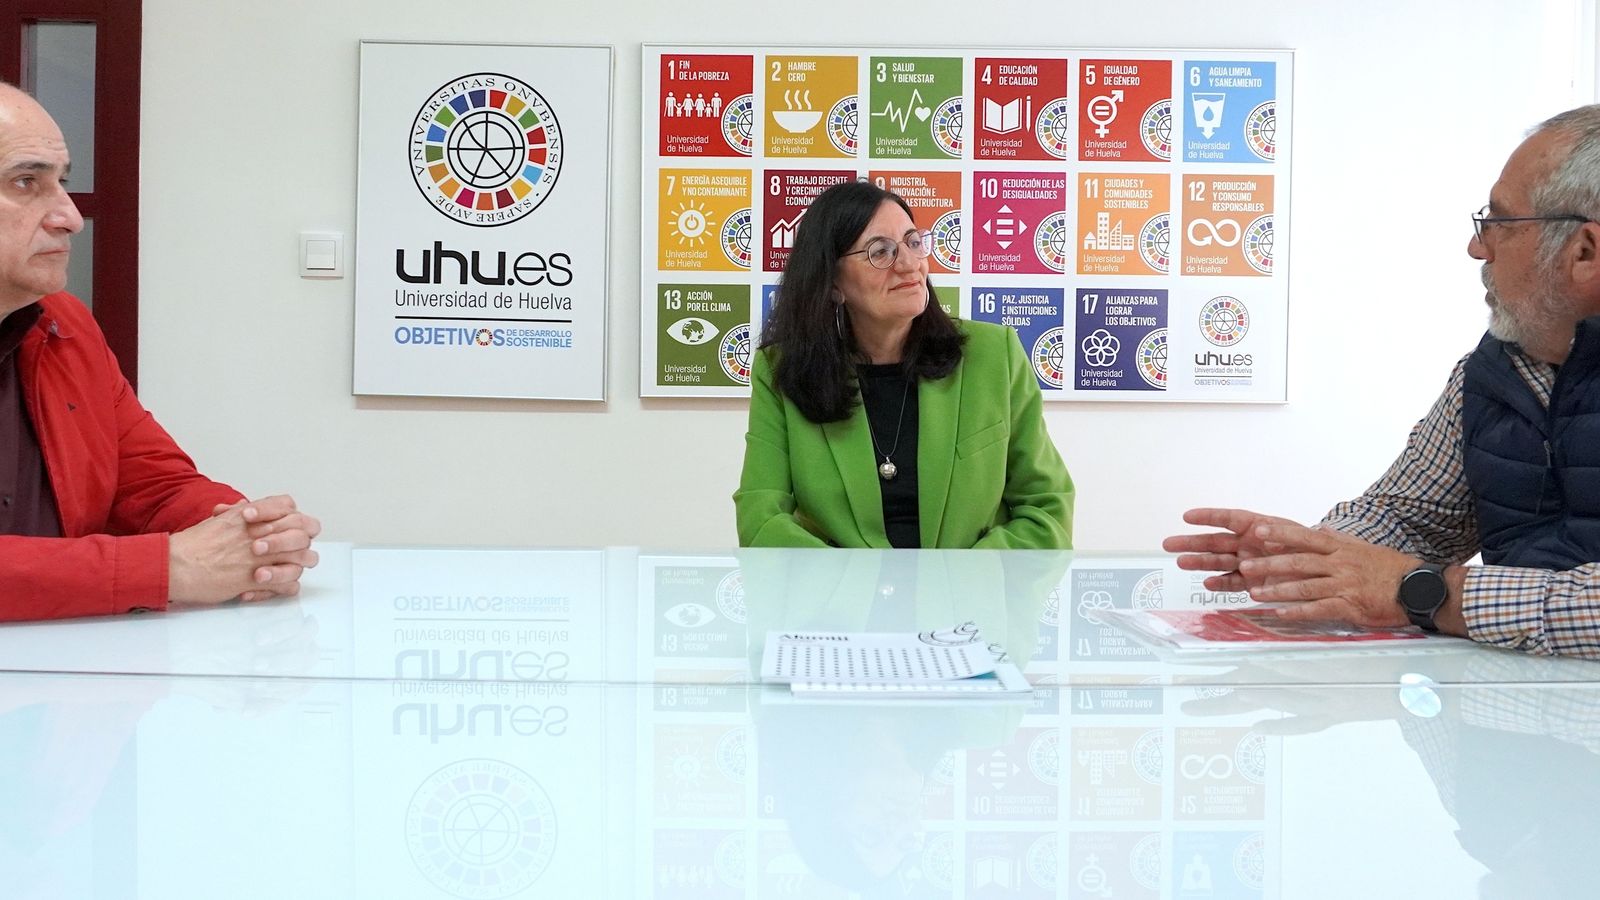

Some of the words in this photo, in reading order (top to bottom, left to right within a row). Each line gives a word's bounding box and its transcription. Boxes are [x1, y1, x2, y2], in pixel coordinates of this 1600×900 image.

[680, 61, 690, 69] FIN
[788, 62, 816, 71] HAMBRE
[892, 63, 914, 72] SALUD
[1000, 64, 1038, 75] EDUCACIÓN
[668, 60, 675, 80] 1
[772, 62, 781, 82] 2
[876, 62, 886, 82] 3
[1104, 66, 1137, 74] IGUALDAD
[1209, 67, 1228, 76] AGUA
[1229, 67, 1251, 76] LIMPIA
[680, 72, 688, 80] DE
[689, 72, 698, 80] LA
[699, 72, 730, 80] POBREZA
[788, 73, 806, 82] CERO
[892, 74, 897, 83] Y
[898, 74, 934, 83] BIENESTAR
[981, 65, 992, 85] 4
[1086, 65, 1096, 85] 5
[1190, 67, 1200, 86] 6
[1000, 77, 1008, 86] DE
[1010, 77, 1038, 86] CALIDAD
[1104, 77, 1112, 86] DE
[1113, 76, 1140, 86] GÉNERO
[1209, 78, 1214, 87] Y
[1215, 78, 1262, 87] SANEAMIENTO
[666, 134, 709, 144] Universidad
[772, 136, 814, 145] Universidad
[876, 137, 918, 146] Universidad
[980, 138, 1022, 147] Universidad
[666, 144, 676, 153] de
[678, 144, 702, 153] Huelva
[1085, 140, 1126, 149] Universidad
[1188, 141, 1230, 150] Universidad
[772, 145, 780, 154] de
[783, 145, 807, 154] Huelva
[876, 146, 885, 155] de
[887, 146, 911, 155] Huelva
[980, 148, 990, 157] de
[992, 148, 1016, 157] Huelva
[1085, 149, 1094, 158] de
[1096, 149, 1120, 158] Huelva
[1188, 150, 1197, 159] de
[1200, 150, 1224, 159] Huelva
[682, 175, 710, 186] ENERGÍA
[711, 175, 747, 186] ASEQUIBLE
[786, 176, 818, 184] TRABAJO
[1003, 178, 1040, 188] REDUCCIÓN
[1042, 178, 1050, 188] DE
[1051, 178, 1064, 188] LAS
[1104, 179, 1139, 188] CIUDADES
[1140, 179, 1143, 188] Y
[667, 176, 675, 195] 7
[770, 176, 781, 195] 8
[980, 178, 998, 198] 10
[1085, 179, 1098, 198] 11
[1212, 181, 1256, 191] PRODUCCIÓN
[682, 187, 686, 196] Y
[687, 187, 696, 196] NO
[697, 187, 747, 196] CONTAMINANTE
[786, 186, 790, 195] Y
[932, 187, 936, 196] E
[1002, 190, 1057, 199] DESIGUALDADES
[1104, 190, 1152, 198] COMUNIDADES
[1189, 181, 1205, 201] 12
[786, 195, 816, 206] ECONÓM
[1212, 192, 1217, 201] Y
[1218, 192, 1251, 201] CONSUMO
[1104, 200, 1148, 209] SOSTENIBLES
[1212, 203, 1264, 212] RESPONSABLES
[665, 250, 708, 259] Universidad
[978, 253, 1020, 262] Universidad
[1083, 254, 1125, 263] Universidad
[396, 241, 572, 286] uhu.es
[665, 260, 675, 268] de
[678, 260, 701, 268] Huelva
[1186, 256, 1228, 264] Universidad
[978, 262, 988, 271] de
[990, 262, 1014, 271] Huelva
[1083, 264, 1092, 272] de
[1095, 264, 1119, 272] Huelva
[1186, 265, 1195, 273] de
[1198, 265, 1222, 273] Huelva
[395, 290, 487, 308] Universidad
[493, 292, 512, 308] de
[520, 292, 572, 310] Huelva
[664, 290, 681, 310] 13
[687, 291, 712, 300] ACCIÓN
[1018, 295, 1049, 304] JUSTICIA
[978, 293, 995, 313] 16
[1082, 294, 1098, 314] 17
[1106, 296, 1139, 305] ALIANZAS
[1140, 296, 1158, 305] PARA
[687, 303, 701, 312] POR
[702, 303, 709, 312] EL
[711, 303, 731, 312] CLIMA
[1002, 306, 1006, 316] E
[1007, 306, 1057, 316] INSTITUCIONES
[1106, 306, 1132, 315] LOGRAR
[1002, 316, 1030, 326] SÓLIDAS
[1106, 317, 1118, 326] LOS
[1120, 317, 1156, 326] OBJETIVOS
[394, 326, 505, 346] OBJETIVOS
[506, 330, 517, 338] DE
[520, 330, 572, 338] DESARROLLO
[506, 337, 572, 348] SOSTENIBLE
[1195, 351, 1252, 366] uhu.es
[664, 364, 706, 373] Universidad
[664, 374, 673, 382] de
[676, 374, 700, 382] Huelva
[1081, 369, 1122, 378] Universidad
[1081, 379, 1090, 387] de
[1092, 379, 1117, 387] Huelva
